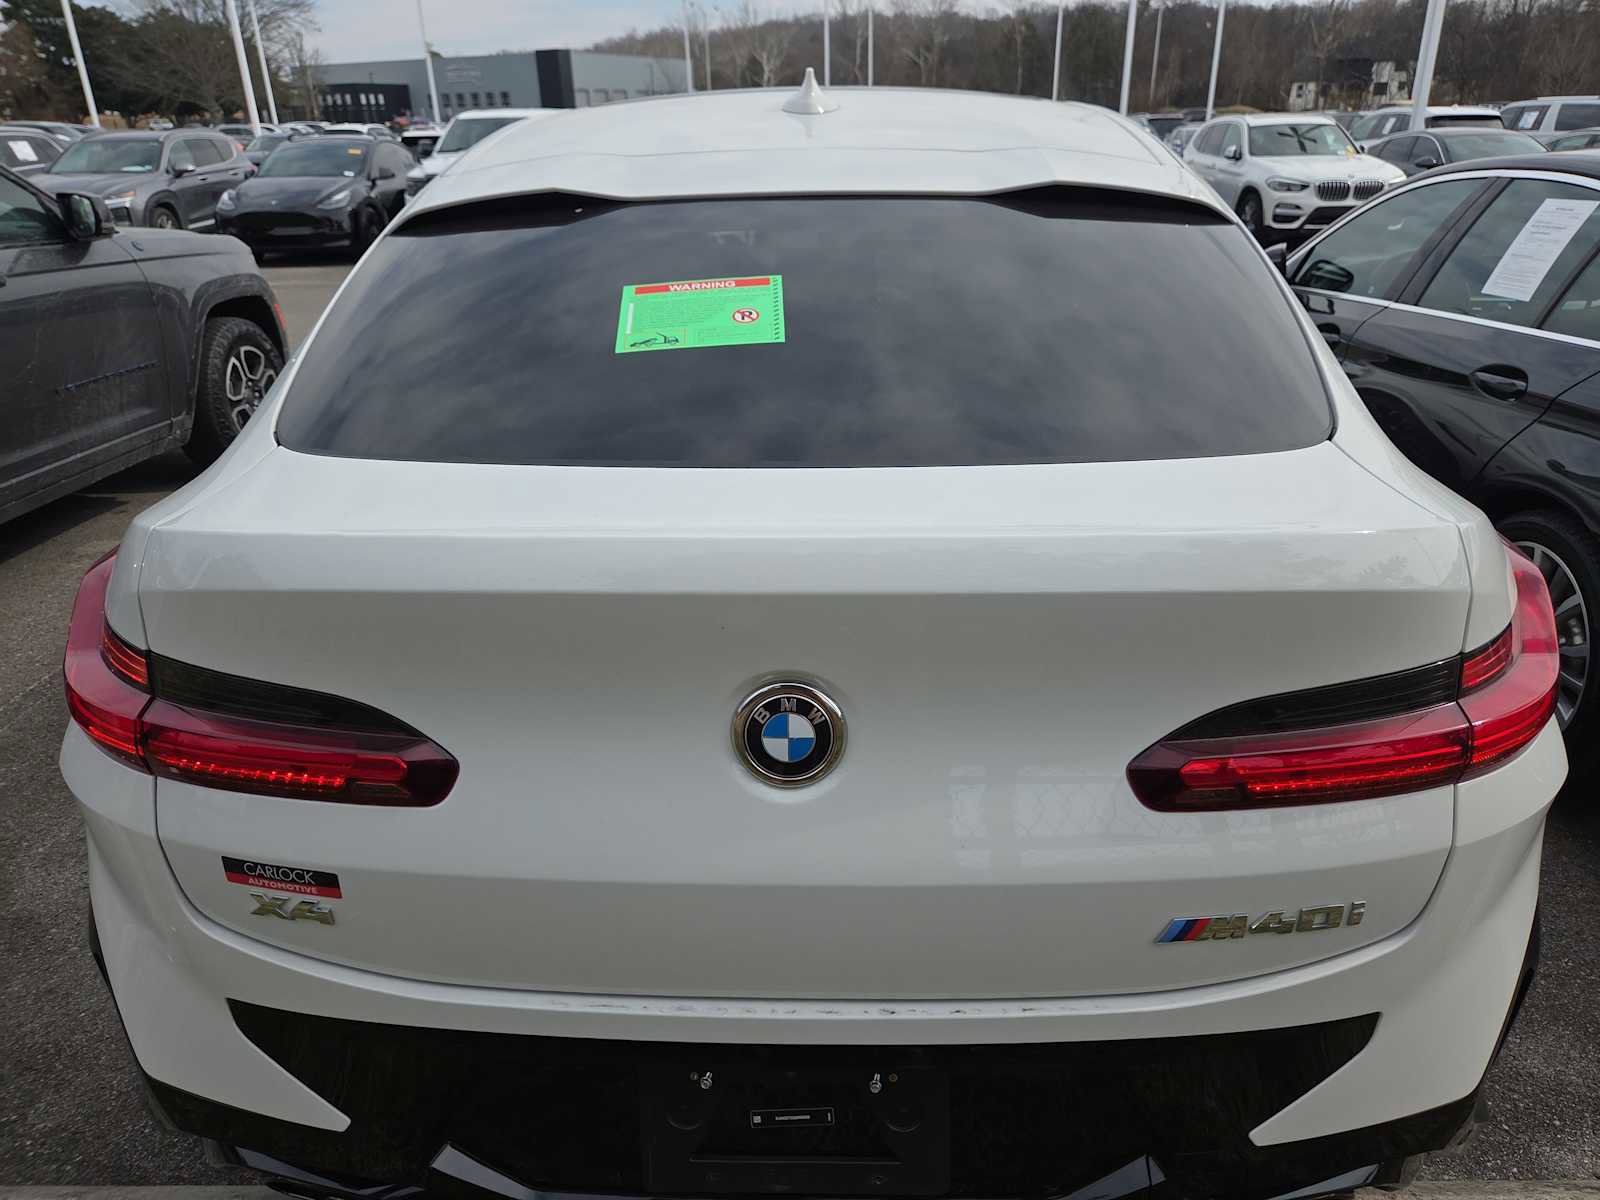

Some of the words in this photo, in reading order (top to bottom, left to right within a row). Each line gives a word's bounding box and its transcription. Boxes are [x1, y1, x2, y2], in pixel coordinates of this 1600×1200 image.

[668, 280, 736, 291] WARNING
[753, 698, 826, 725] BMW
[244, 862, 316, 884] CARLOCK
[248, 878, 319, 894] AUTOMOTIVE
[250, 892, 335, 925] X4
[1199, 899, 1367, 940] M40i
